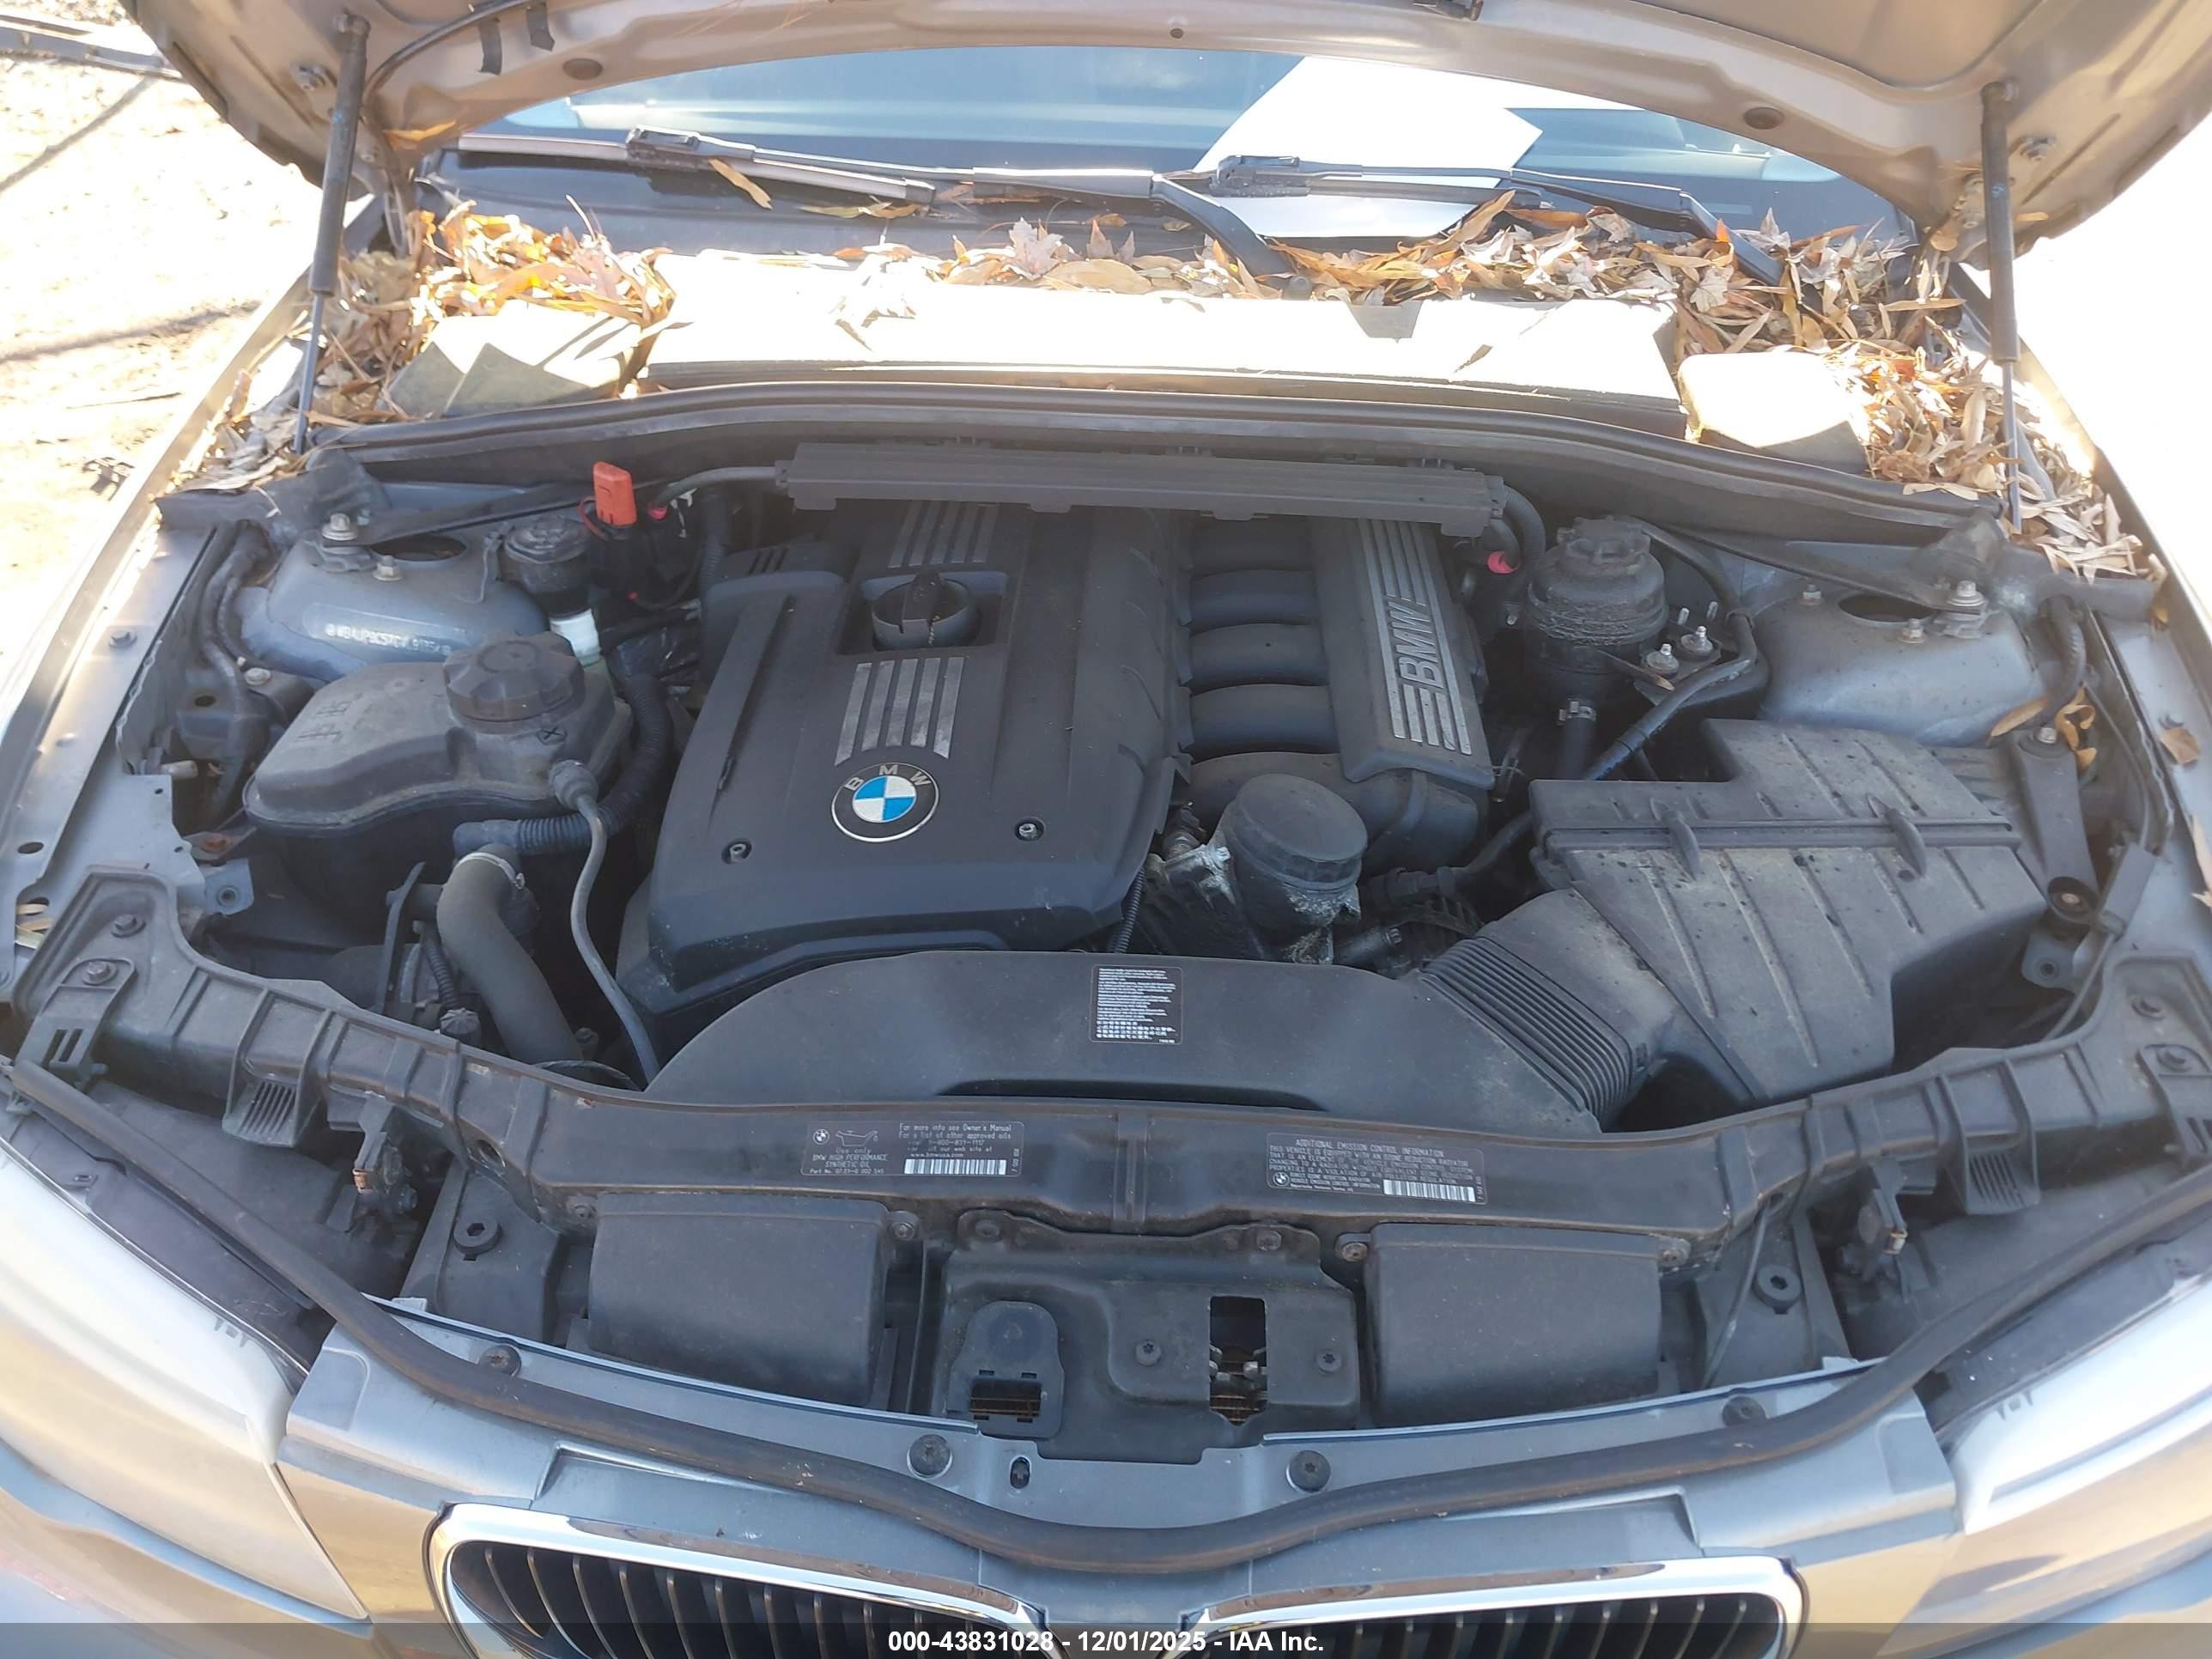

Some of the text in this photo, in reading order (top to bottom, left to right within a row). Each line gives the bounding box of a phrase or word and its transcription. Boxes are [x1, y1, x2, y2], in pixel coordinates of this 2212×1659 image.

[1388, 600, 1444, 689] BMW
[845, 764, 932, 791] BMW
[900, 1122, 910, 1131] For
[963, 1123, 987, 1132] Owner's
[989, 1123, 1012, 1132] Manual
[967, 1132, 995, 1140] approved
[1296, 1139, 1444, 1158] ADDITIONAL EMISSION CONTROL INFORMATION
